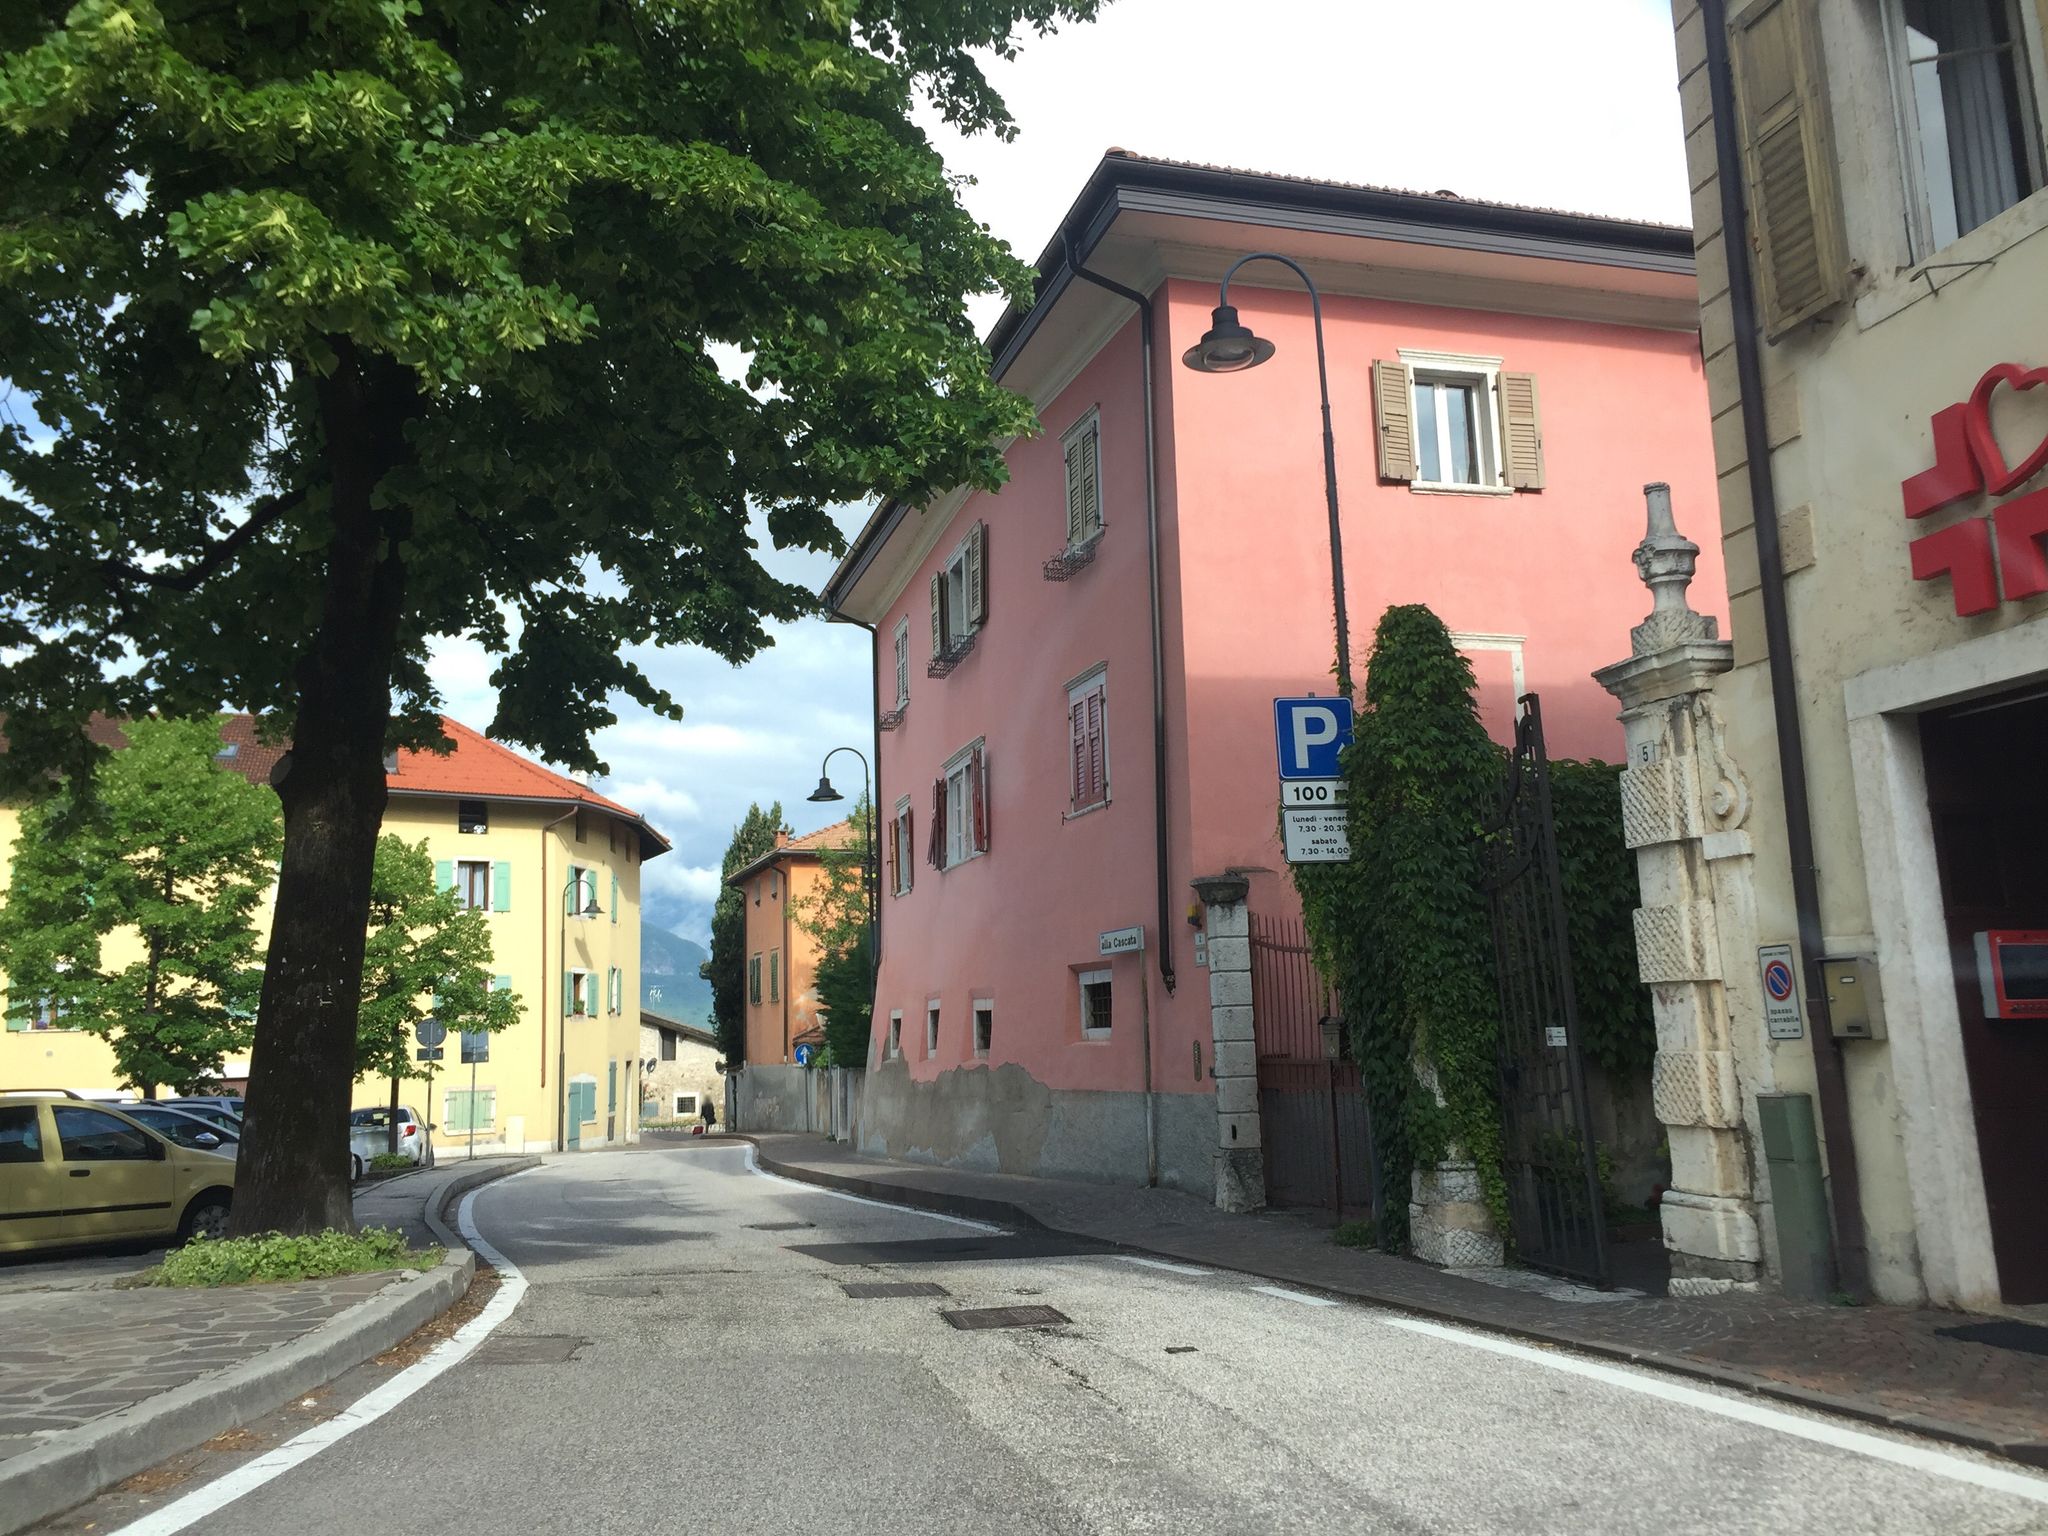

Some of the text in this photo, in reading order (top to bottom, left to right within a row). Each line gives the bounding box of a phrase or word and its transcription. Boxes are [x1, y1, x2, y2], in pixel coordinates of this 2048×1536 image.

[1291, 706, 1338, 769] P
[1642, 746, 1649, 762] 5
[1293, 786, 1328, 801] 100
[1298, 825, 1317, 833] 7.30
[1326, 847, 1349, 855] 14.00
[1113, 935, 1137, 948] Cascata
